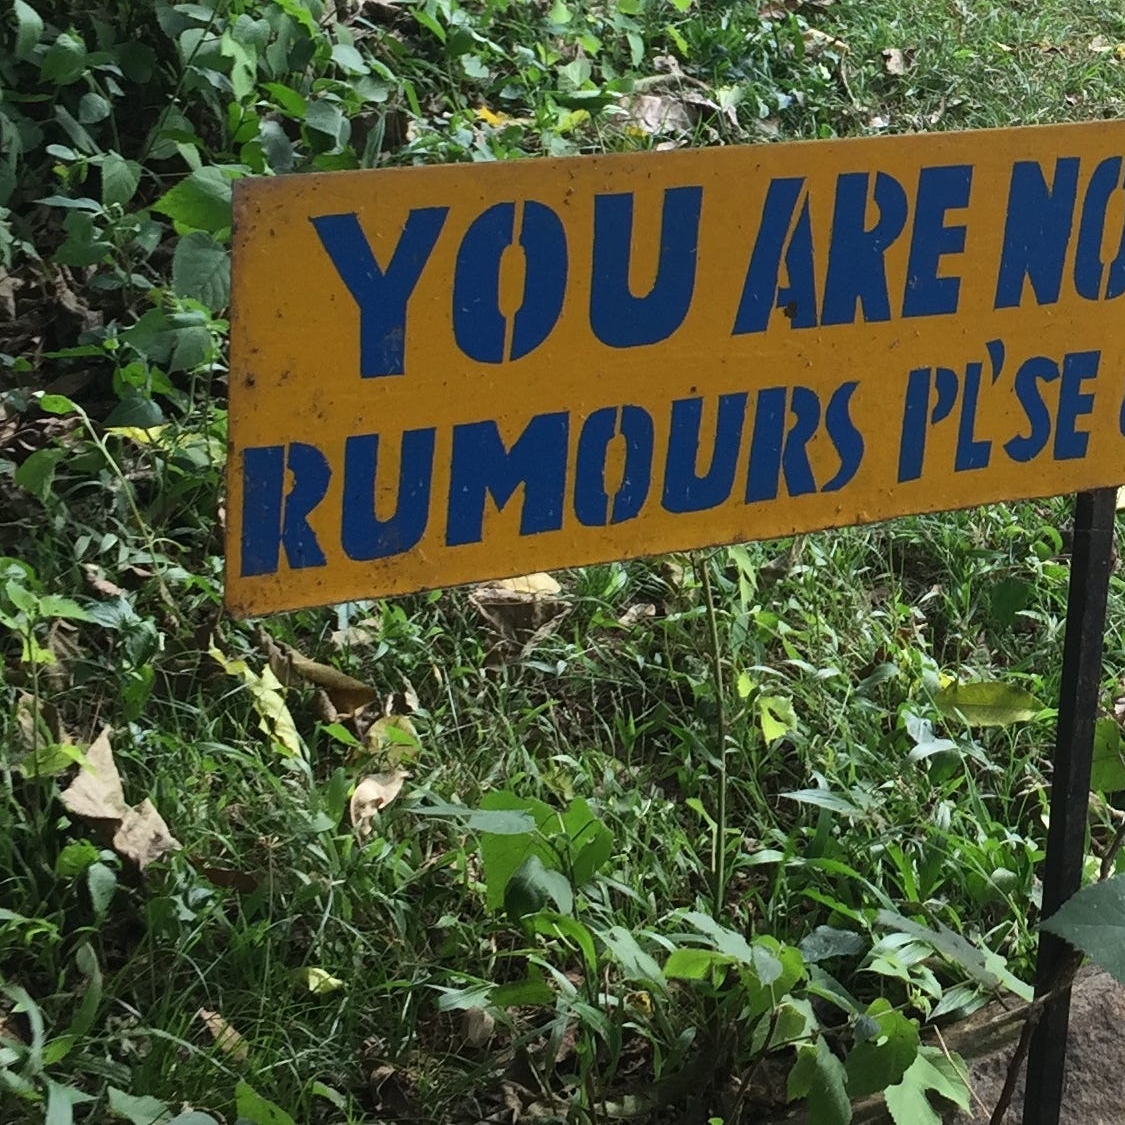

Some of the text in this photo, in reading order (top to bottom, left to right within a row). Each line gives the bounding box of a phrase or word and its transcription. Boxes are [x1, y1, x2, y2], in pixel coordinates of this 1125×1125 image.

[310, 185, 703, 379] YOU
[731, 165, 975, 336] ARE
[240, 381, 864, 576] RUMOURS
[897, 339, 1100, 484] PL'SE
